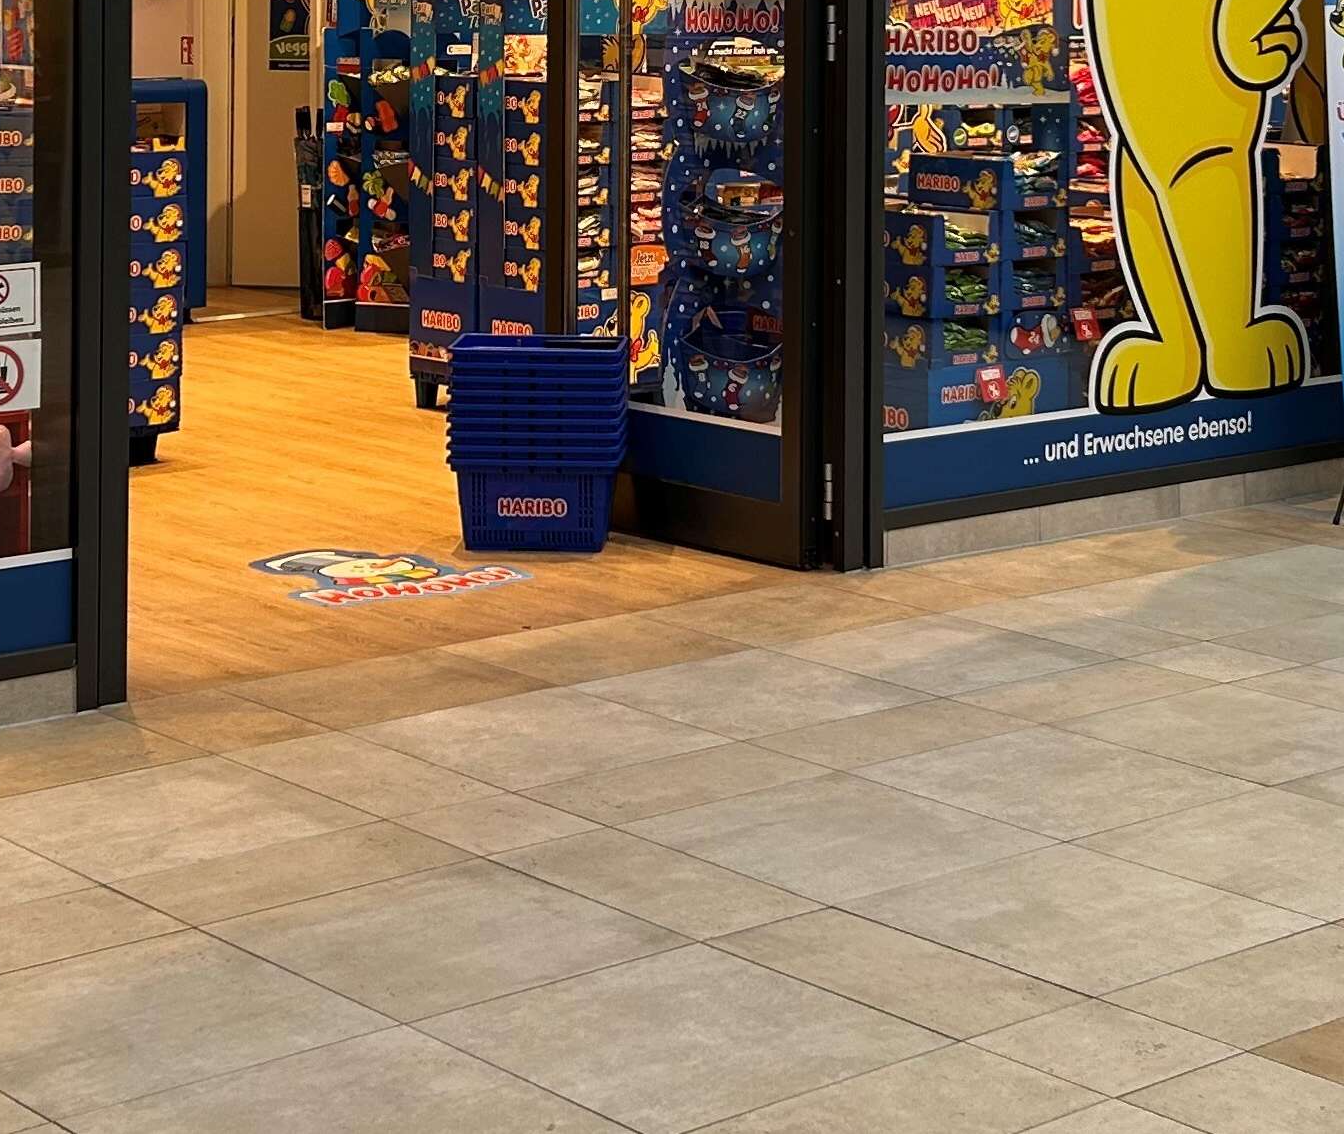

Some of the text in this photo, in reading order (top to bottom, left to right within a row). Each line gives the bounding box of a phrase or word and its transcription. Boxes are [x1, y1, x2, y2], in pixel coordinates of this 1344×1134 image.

[886, 29, 977, 53] HARIBO
[916, 173, 960, 192] HARIBO
[422, 311, 461, 330] HARIBO
[1044, 434, 1080, 463] und
[1083, 425, 1184, 457] Erwachsene
[1188, 409, 1253, 440] ebenso!
[497, 497, 568, 517] HARIBO
